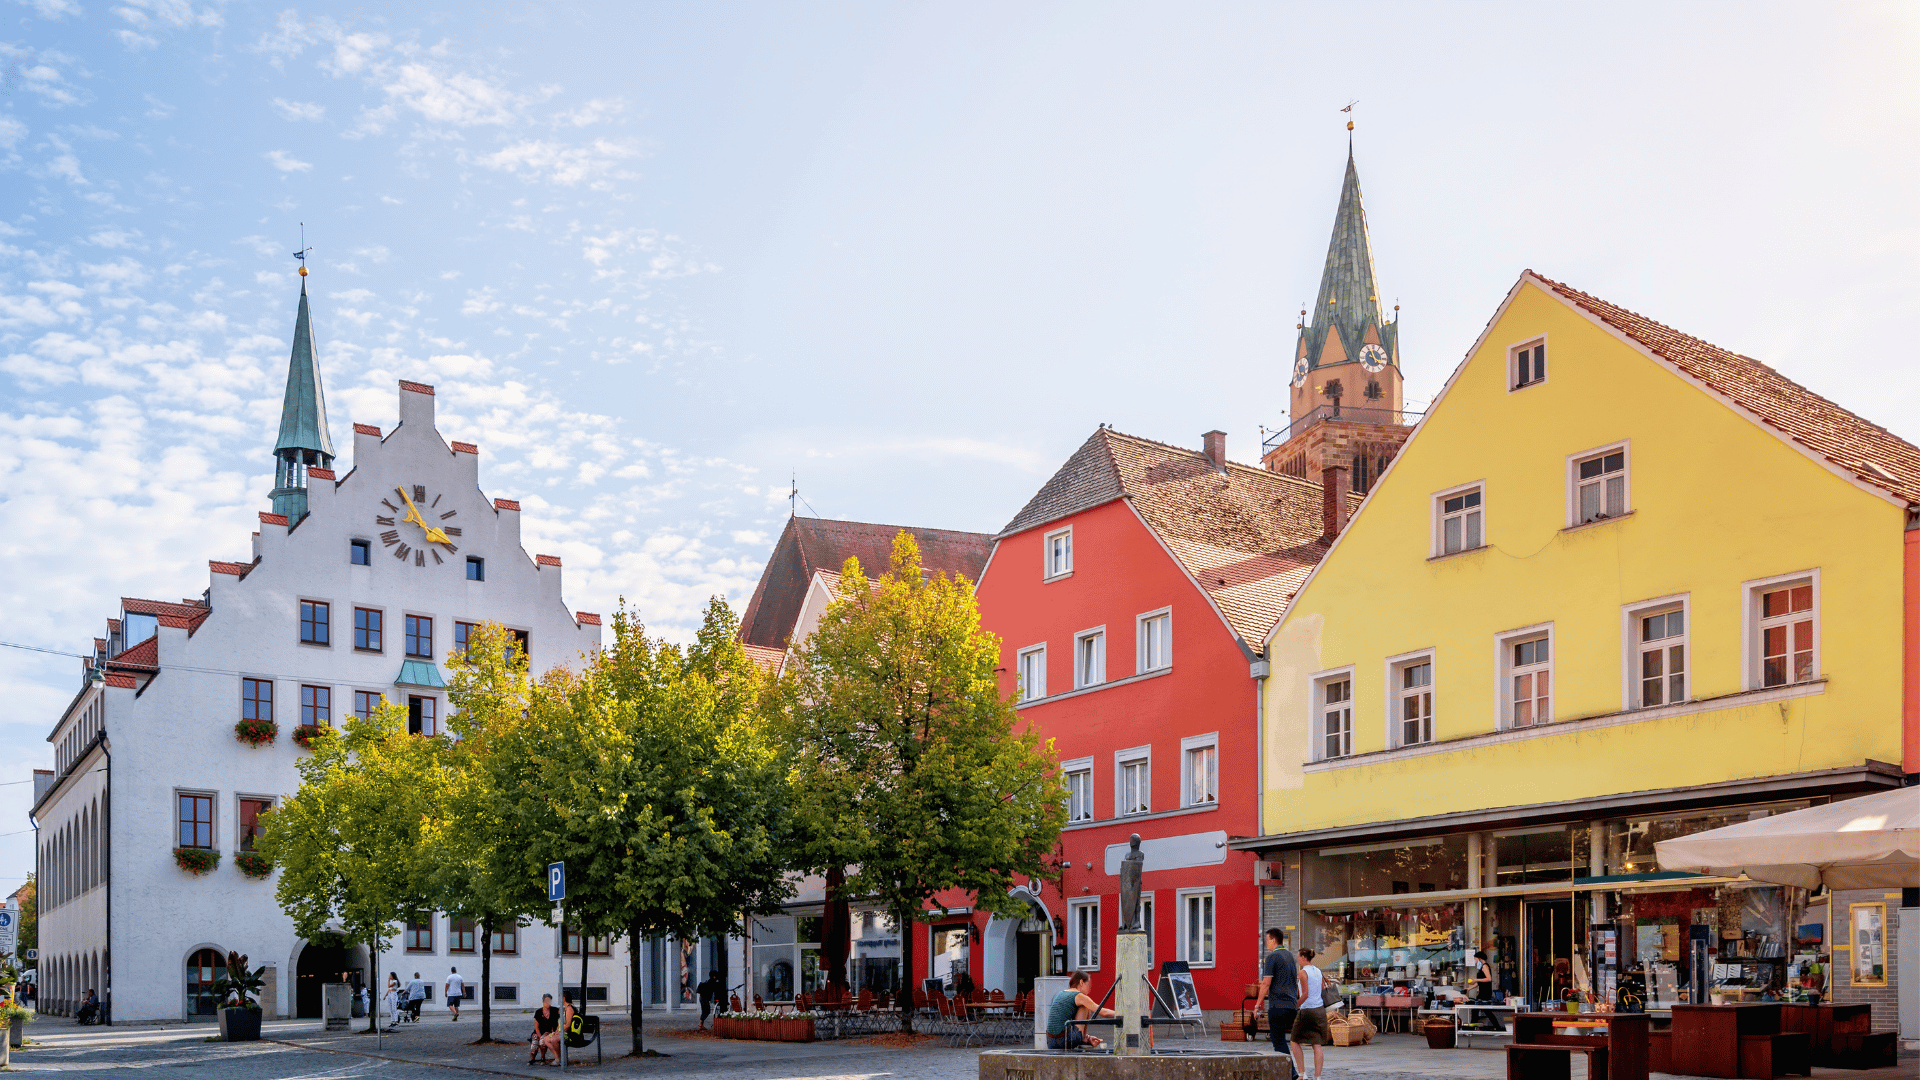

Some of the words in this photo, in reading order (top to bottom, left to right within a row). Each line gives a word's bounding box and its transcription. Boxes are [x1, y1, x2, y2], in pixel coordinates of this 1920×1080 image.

[381, 498, 399, 513] X
[440, 510, 457, 520] II
[432, 548, 444, 565] V
[552, 868, 561, 895] P
